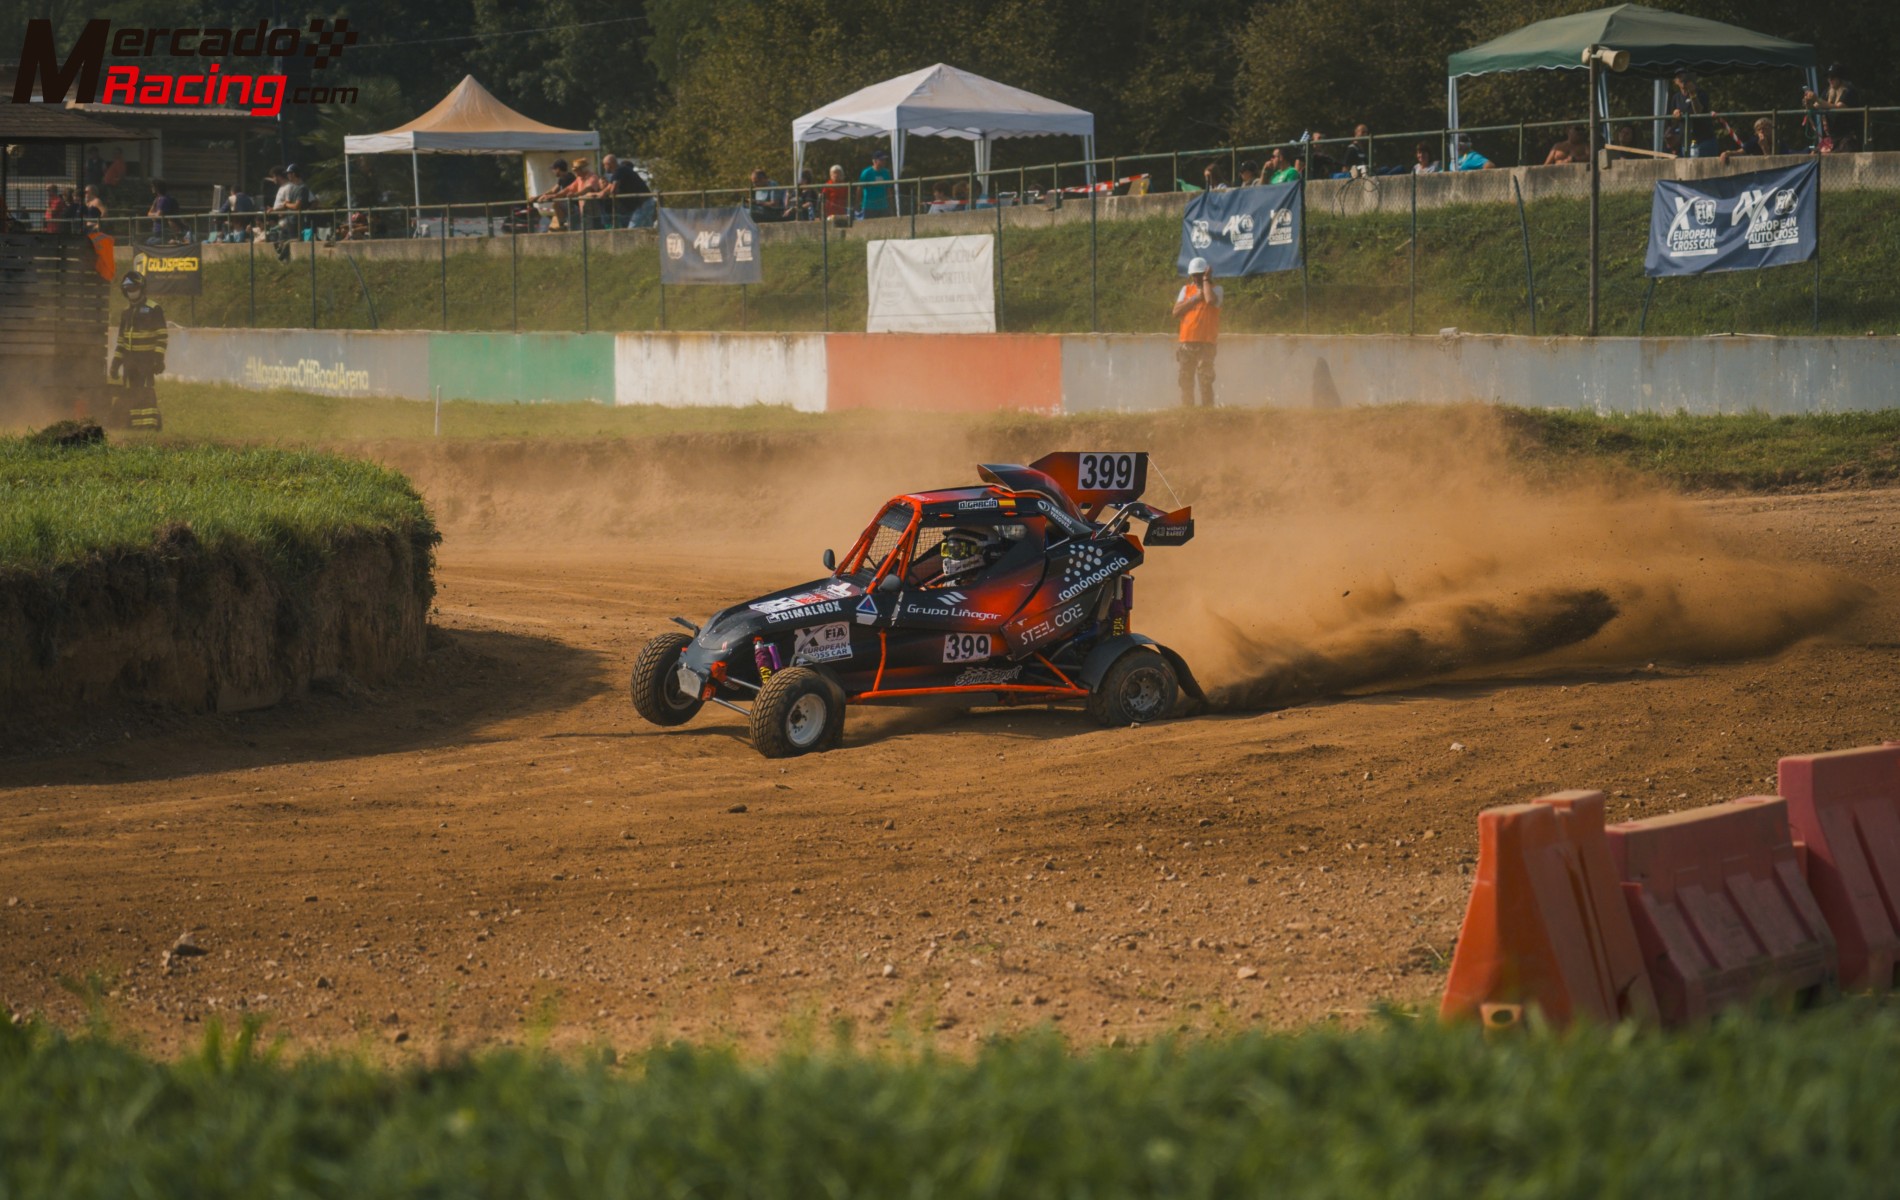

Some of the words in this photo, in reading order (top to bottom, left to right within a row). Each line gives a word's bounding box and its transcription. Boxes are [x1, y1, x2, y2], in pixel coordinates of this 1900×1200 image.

[1673, 228, 1717, 241] EUROPEAN
[1672, 239, 1698, 251] CROSS
[1699, 238, 1716, 249] CAR
[1080, 454, 1132, 489] 399
[1058, 556, 1129, 601] ramóngarcía
[780, 601, 842, 621] DIMALNOX
[906, 604, 949, 616] Grupo
[951, 607, 1002, 621] Liñagar
[825, 627, 845, 639] FIA
[1020, 621, 1056, 645] STEEL
[1055, 603, 1084, 627] CORE
[803, 642, 847, 655] EUROPEAN
[945, 634, 990, 660] 399
